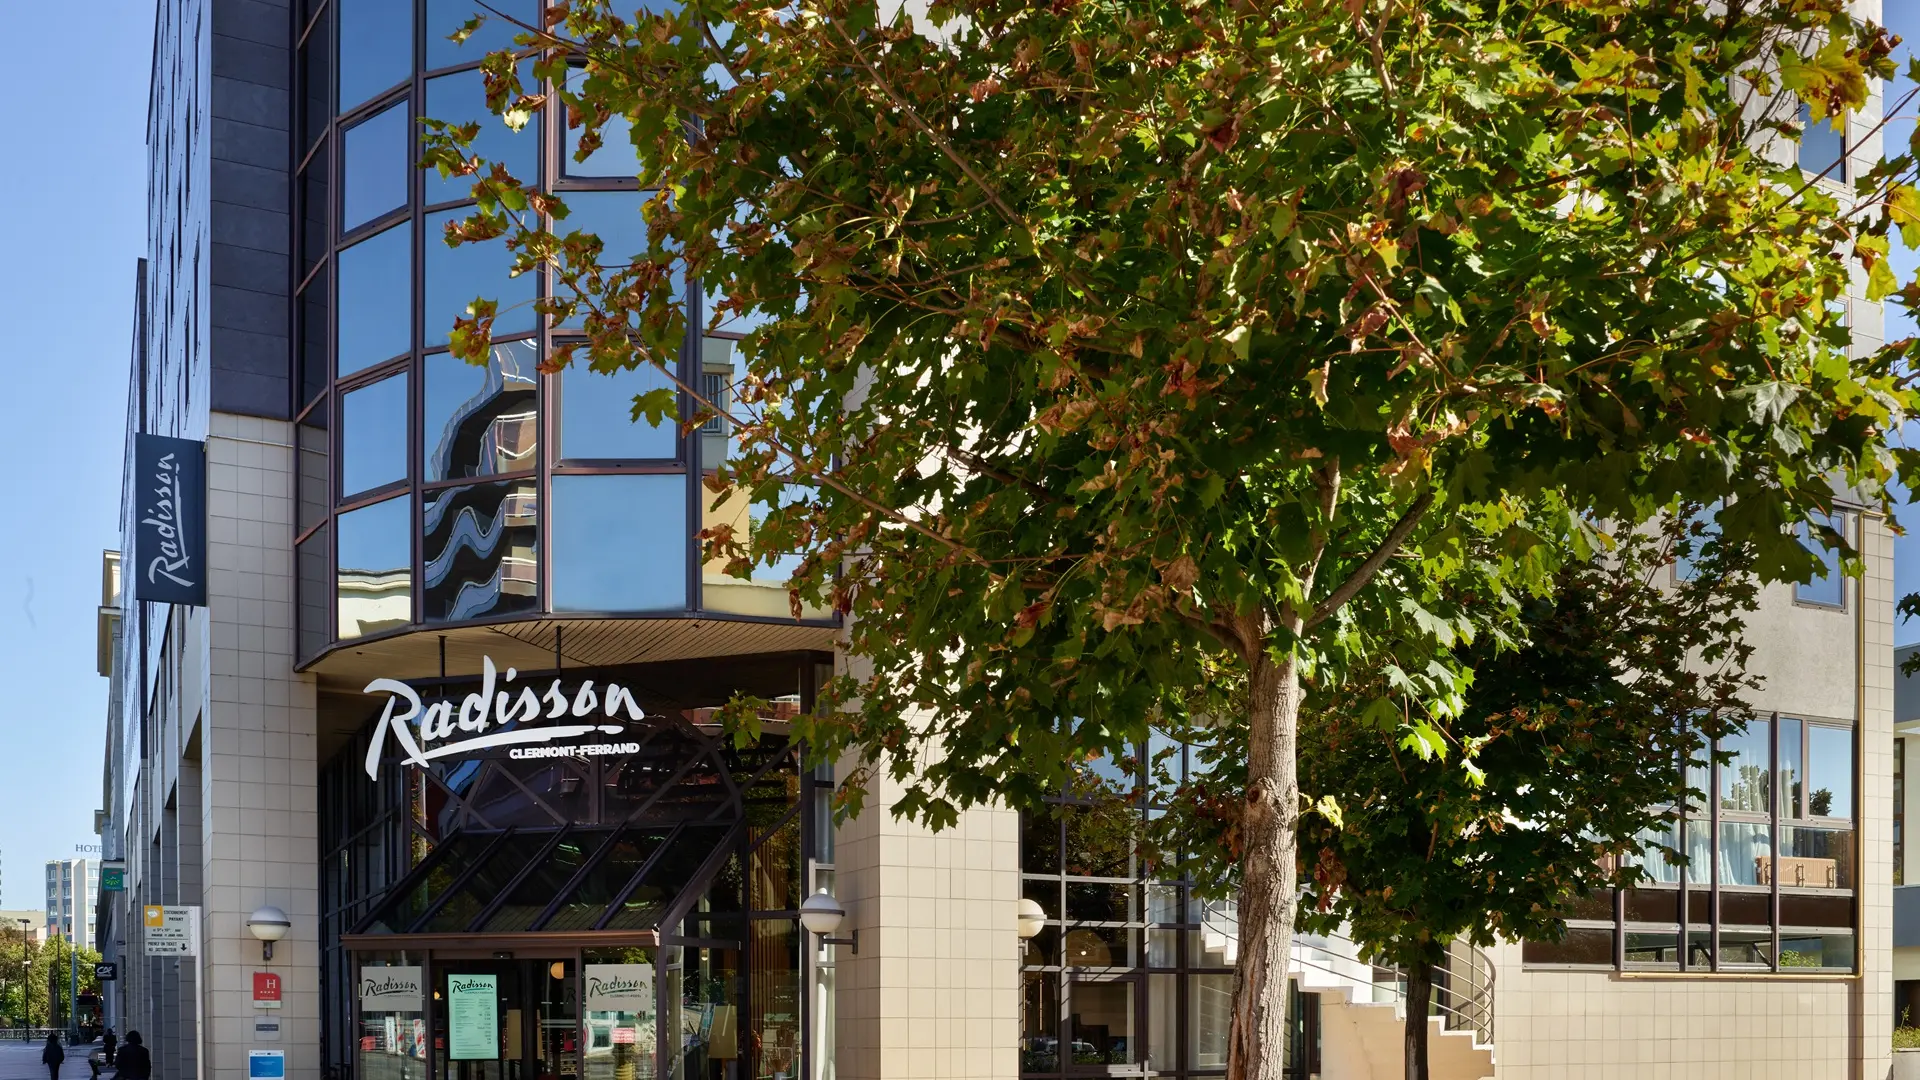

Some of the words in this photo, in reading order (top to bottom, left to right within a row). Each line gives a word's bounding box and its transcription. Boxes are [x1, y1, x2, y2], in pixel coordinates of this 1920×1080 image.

[141, 453, 195, 588] Radisson
[363, 655, 645, 782] Radisson
[509, 742, 640, 760] CLERMONT-FERRAND
[266, 979, 276, 989] H
[365, 976, 418, 997] Radisson
[452, 979, 494, 994] Radisson
[589, 975, 648, 998] Radisson
